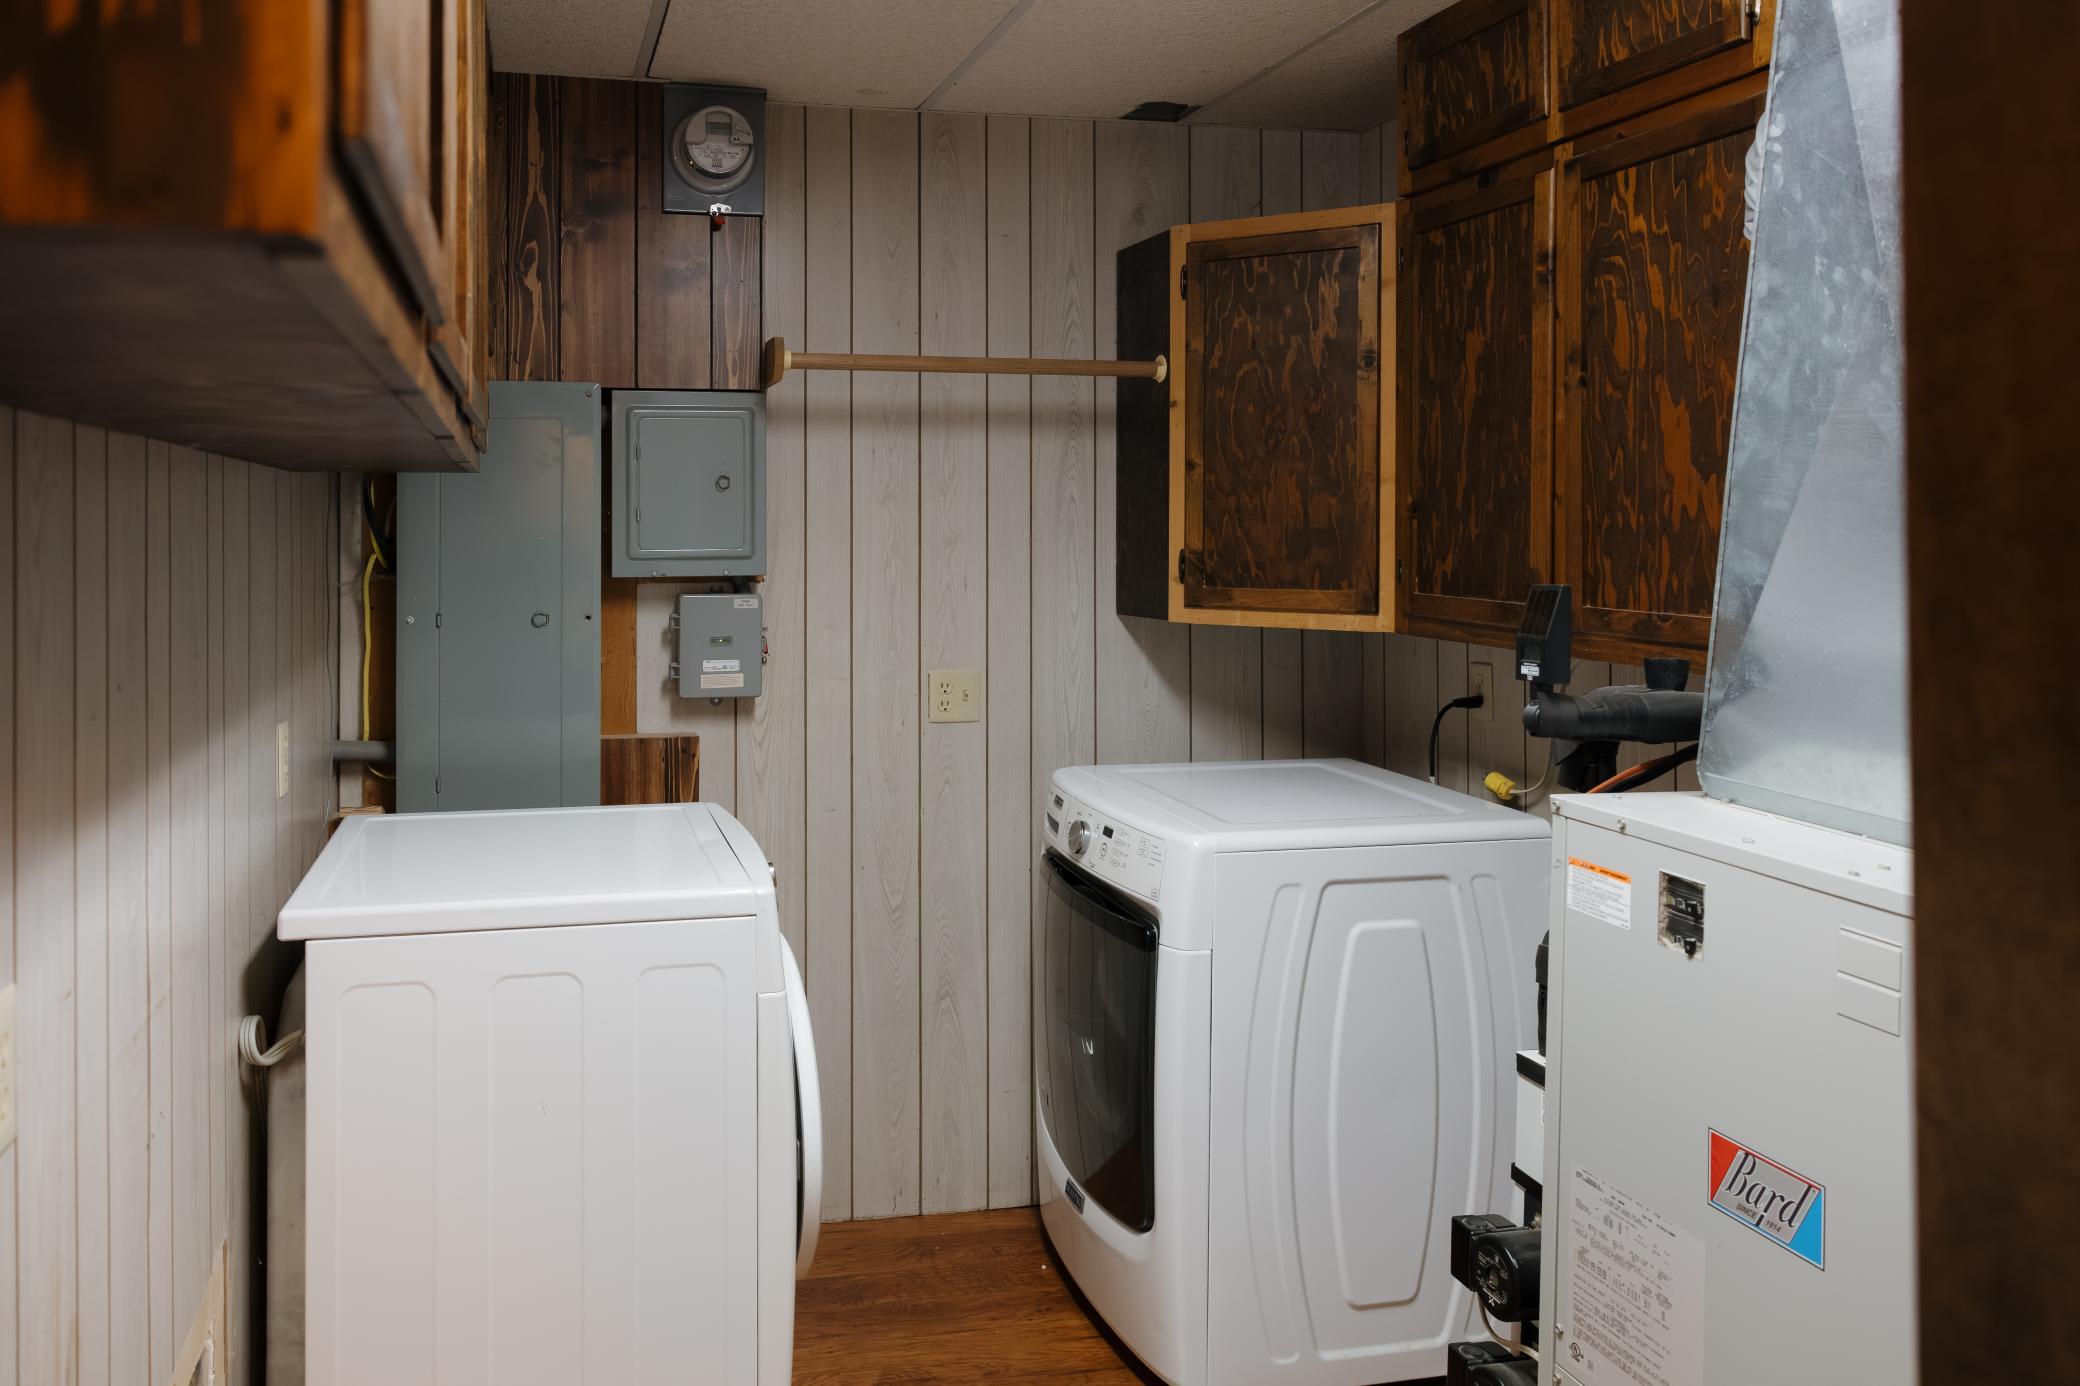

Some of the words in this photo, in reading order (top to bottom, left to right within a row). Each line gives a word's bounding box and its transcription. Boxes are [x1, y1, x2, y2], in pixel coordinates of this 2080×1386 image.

[1724, 1151, 1813, 1228] Bard
[1736, 1203, 1758, 1219] SINCE
[1765, 1220, 1782, 1233] 1914
